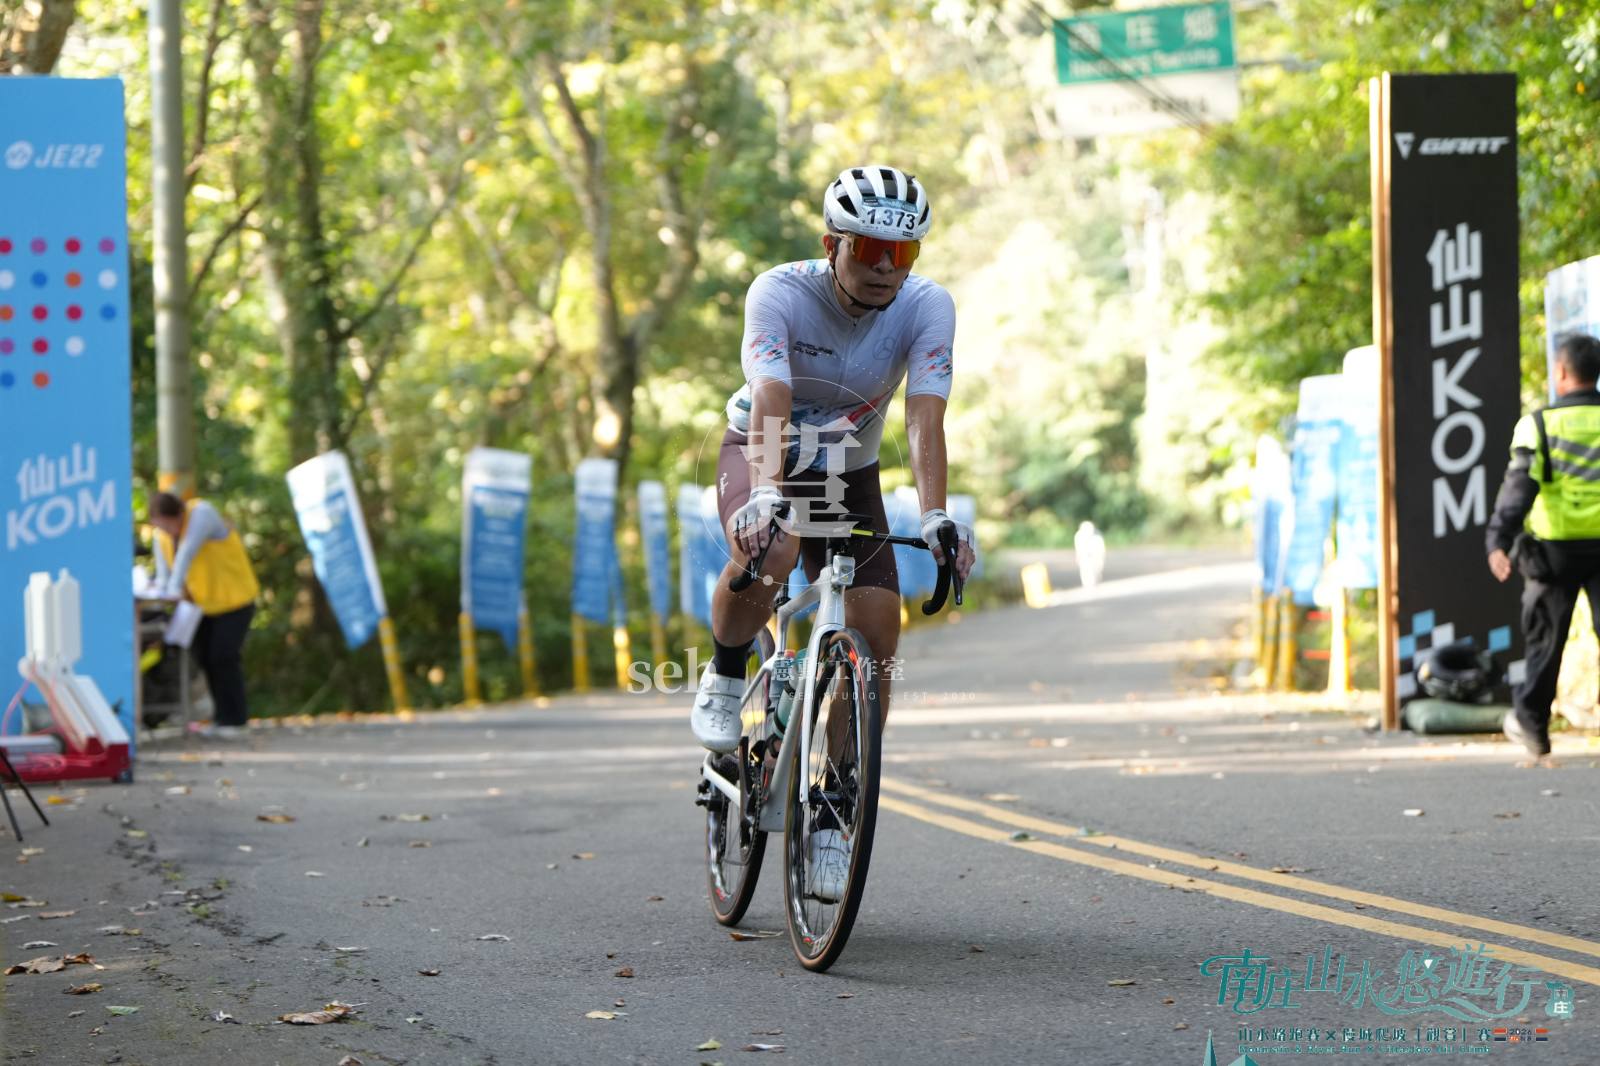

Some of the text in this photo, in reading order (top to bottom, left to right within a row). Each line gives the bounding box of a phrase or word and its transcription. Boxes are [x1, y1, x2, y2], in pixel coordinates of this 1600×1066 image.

[34, 143, 104, 168] JE22
[1418, 136, 1510, 155] GIANT
[17, 443, 97, 502] 仙山
[6, 480, 117, 551] KOM
